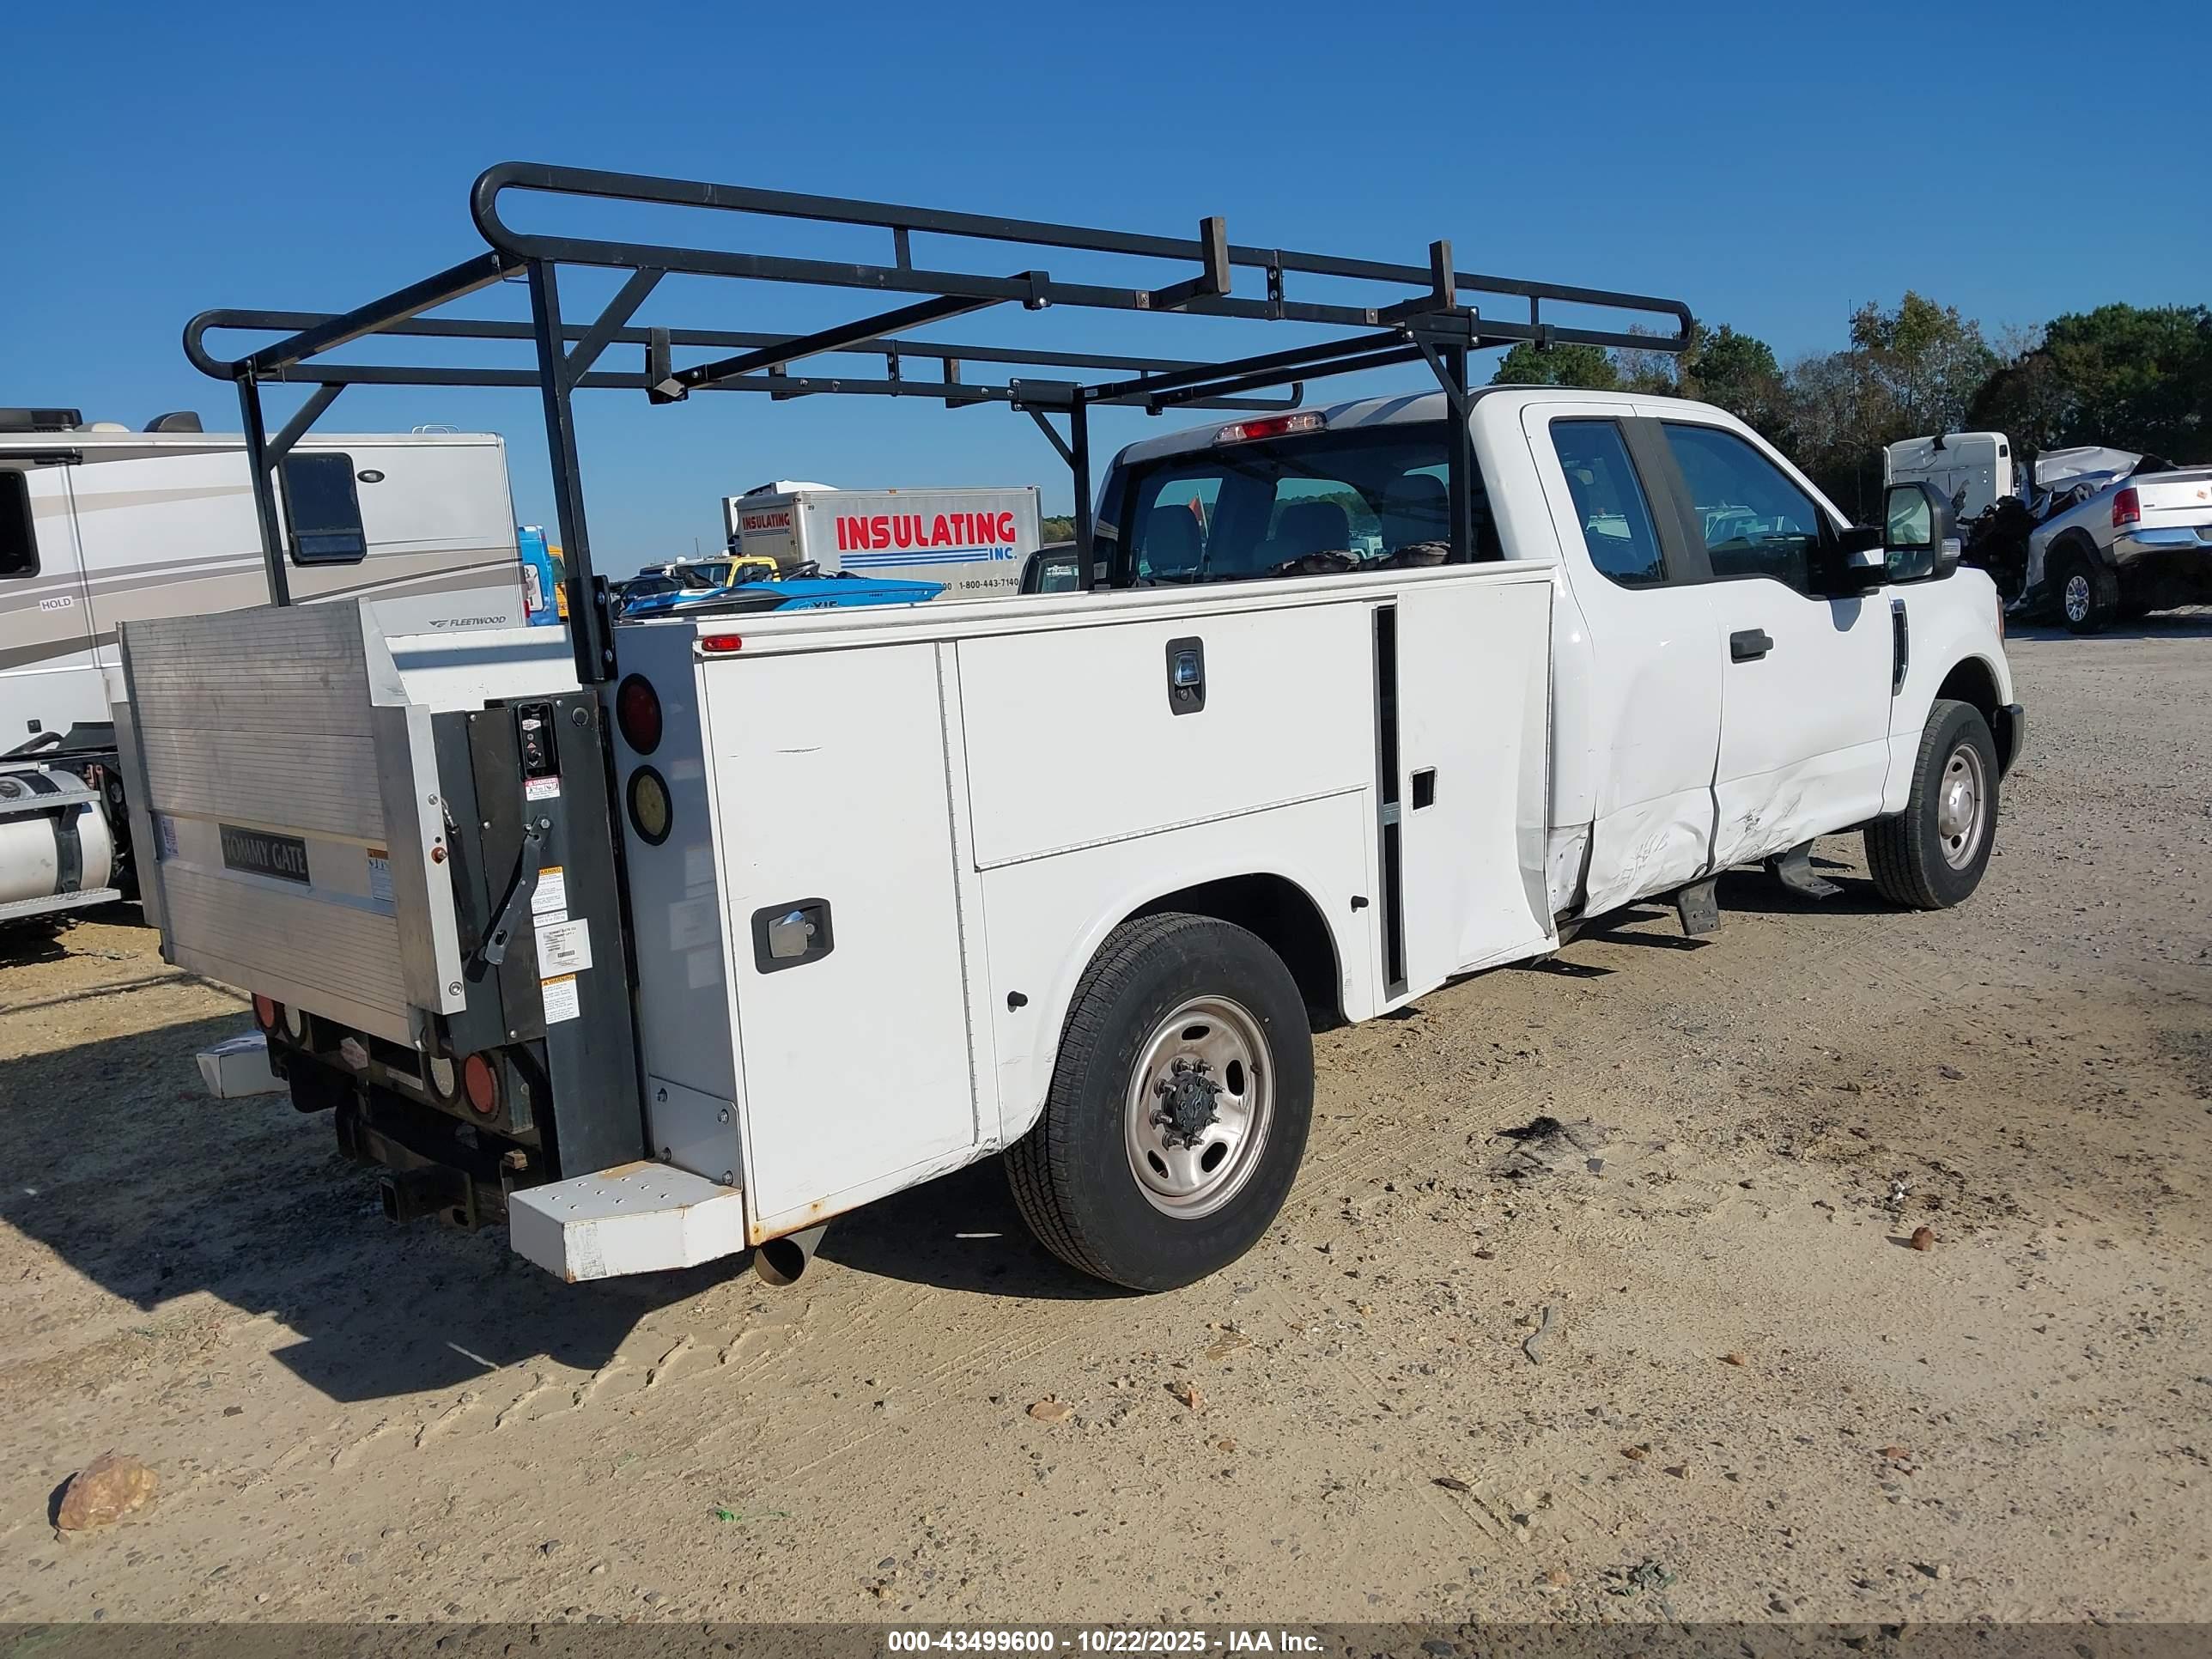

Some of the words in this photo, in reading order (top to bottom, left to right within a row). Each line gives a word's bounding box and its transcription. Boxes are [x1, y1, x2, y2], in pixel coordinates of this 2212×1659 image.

[742, 513, 791, 531] INSULATING
[836, 512, 1017, 550] INSULATING
[988, 547, 1018, 561] INC.
[959, 578, 1019, 590] 1-800-443-7140
[41, 598, 71, 610] HOLD
[449, 616, 507, 627] FLEETWOOD
[222, 836, 269, 866] TOMMY
[271, 842, 307, 874] GATE
[549, 975, 574, 985] WARNING
